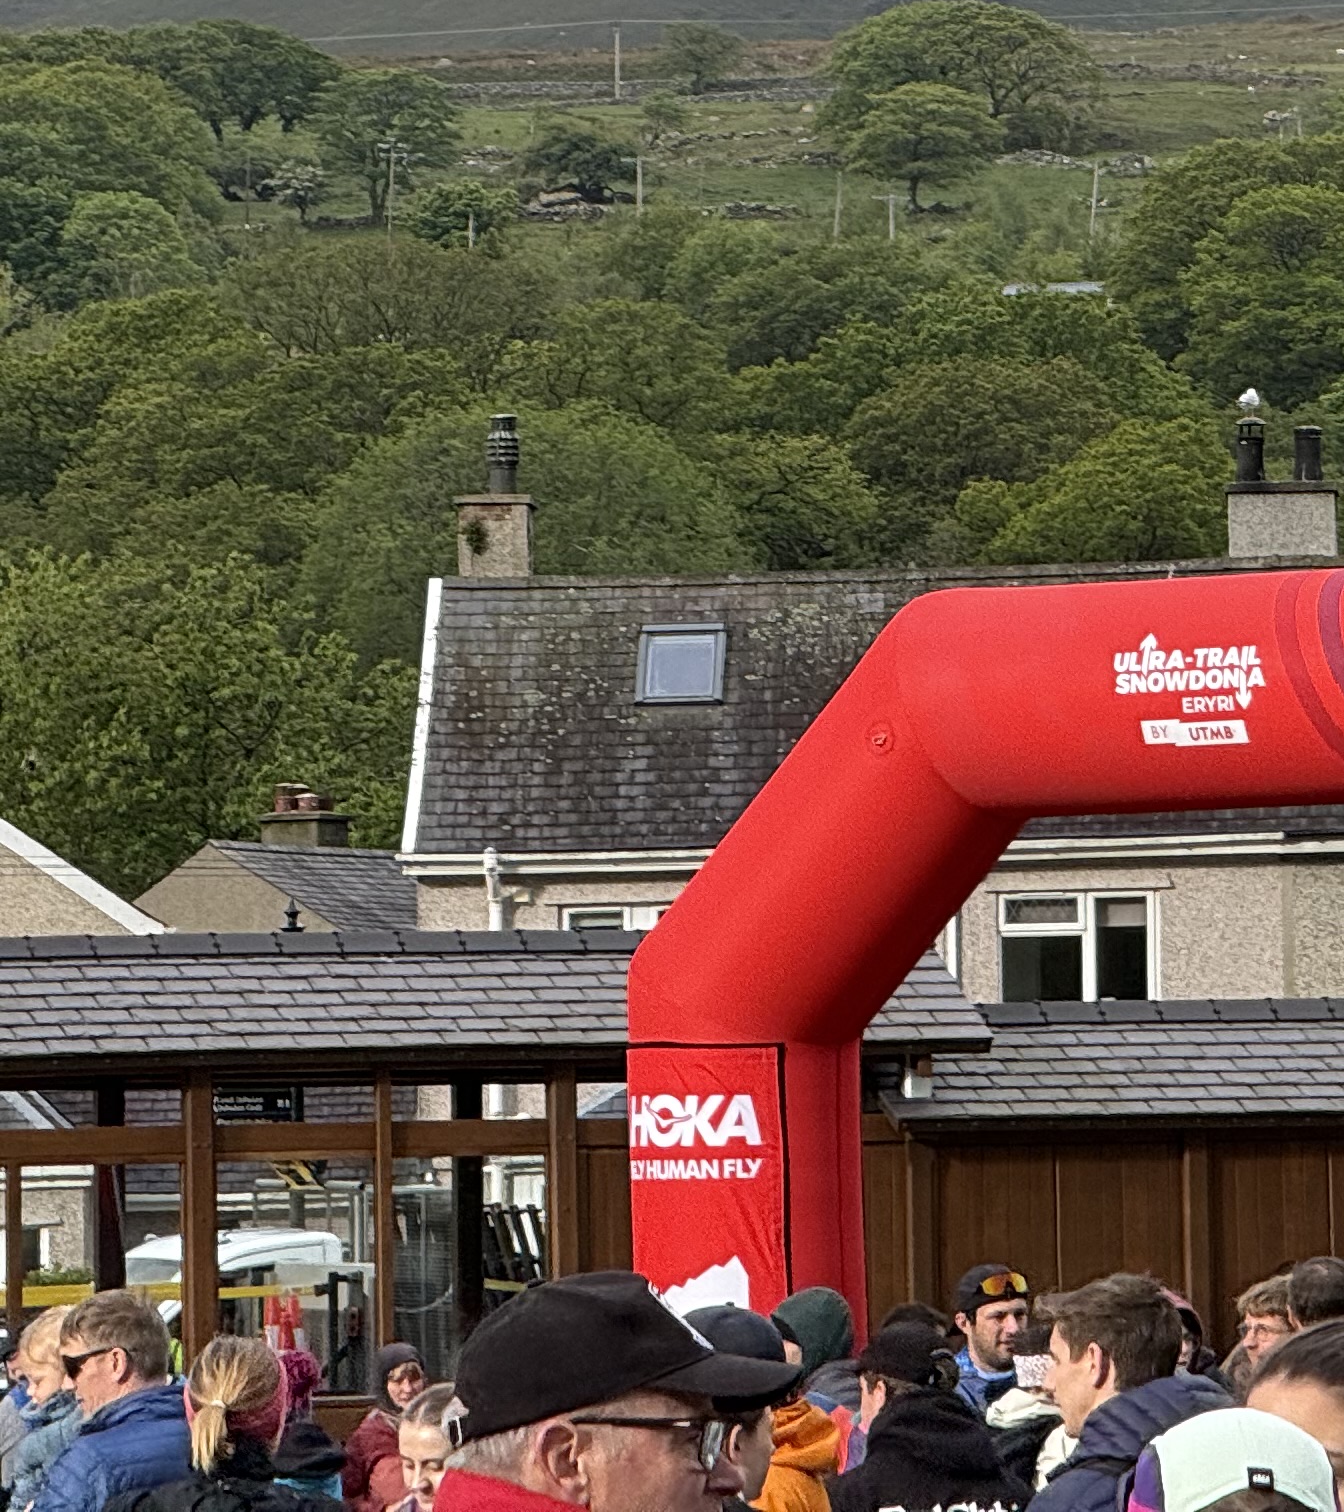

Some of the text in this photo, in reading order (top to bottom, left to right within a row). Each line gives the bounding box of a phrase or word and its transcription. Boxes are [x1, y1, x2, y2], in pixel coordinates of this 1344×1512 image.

[1113, 635, 1261, 673] ULTRA-TRAIL
[1114, 666, 1266, 696] SNOWDONIA
[1182, 695, 1235, 714] ERYRI
[1151, 724, 1235, 742] BY UTMB
[631, 1094, 762, 1147] HOKA
[646, 1158, 720, 1180] HUMAN
[723, 1157, 763, 1179] FLY
